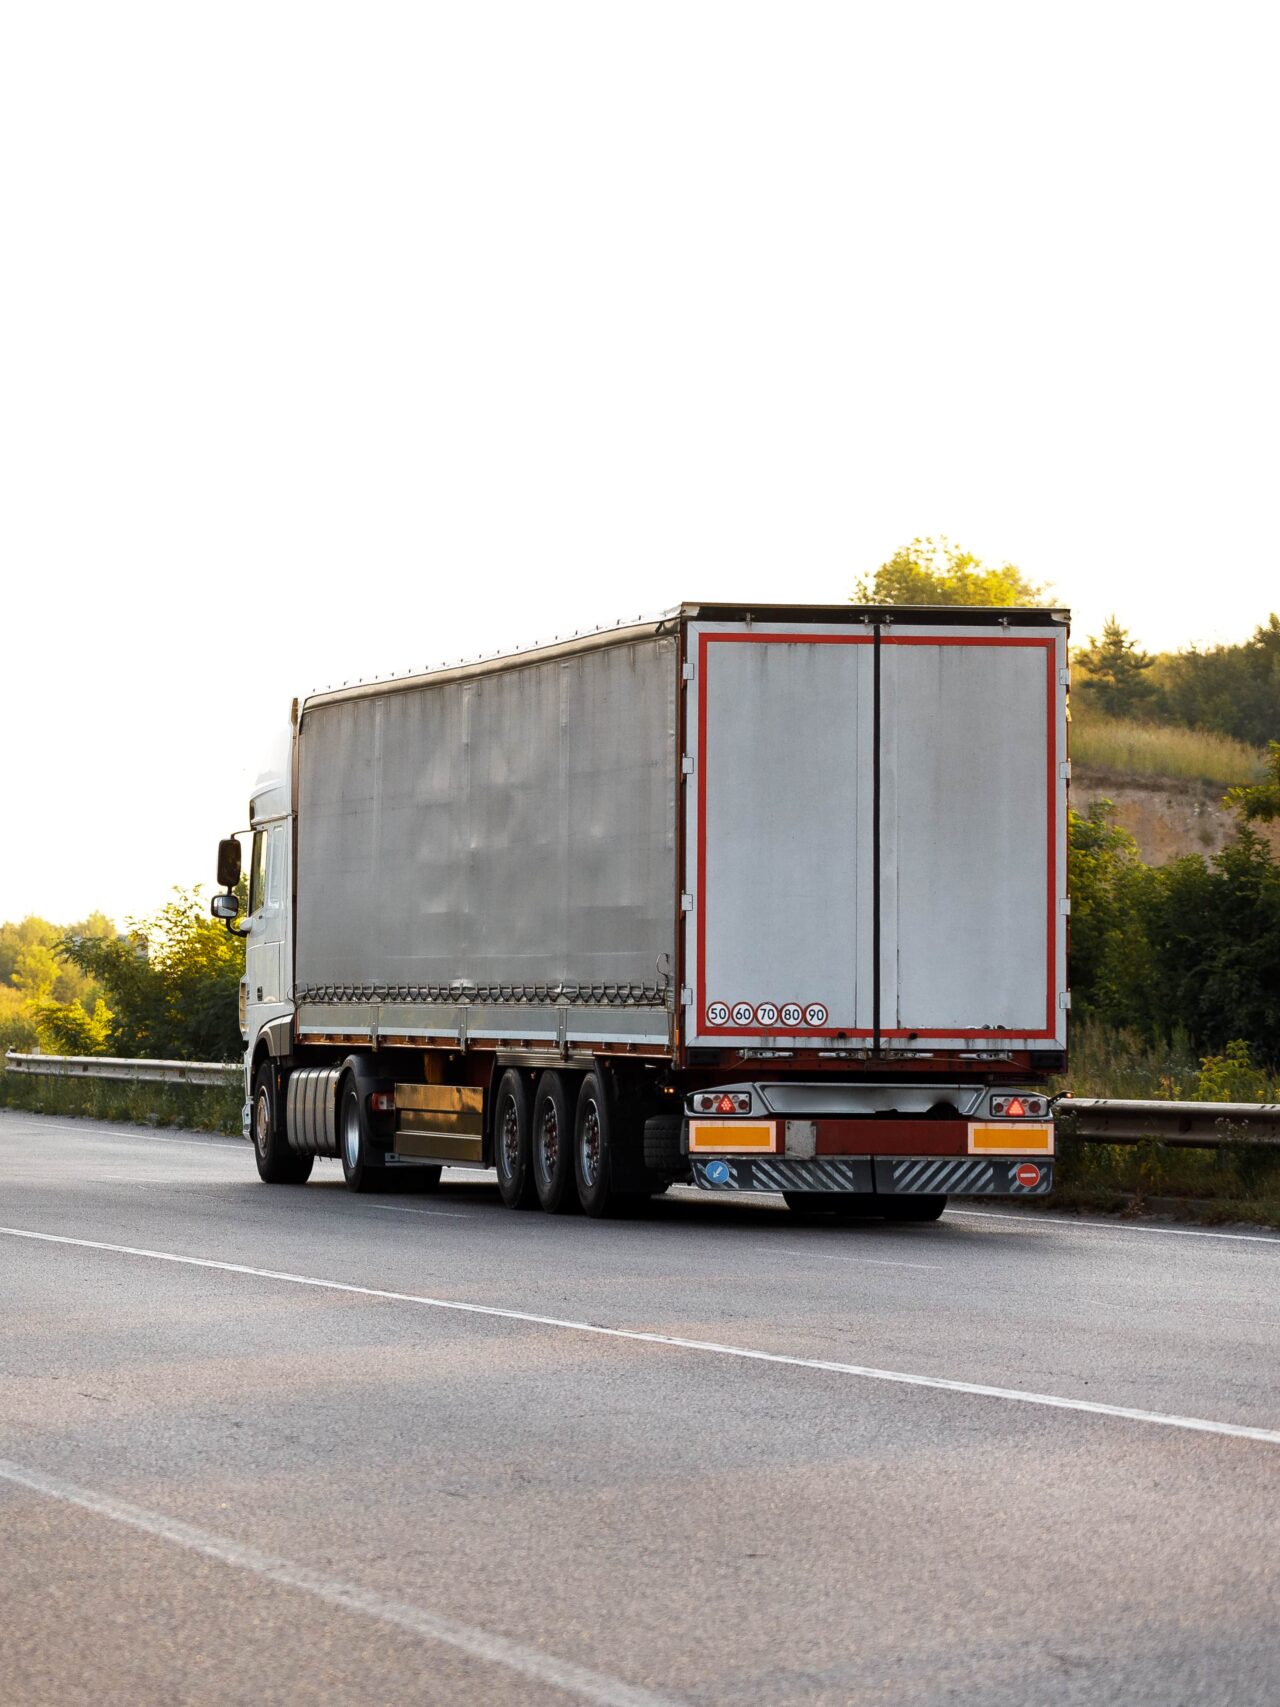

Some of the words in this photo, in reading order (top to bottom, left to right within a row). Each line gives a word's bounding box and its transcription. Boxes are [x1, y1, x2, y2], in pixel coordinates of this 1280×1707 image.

[710, 1008, 727, 1020] 50
[735, 1008, 751, 1020] 60
[760, 1008, 775, 1020] 70
[784, 1009, 800, 1021] 80
[808, 1009, 824, 1021] 90
